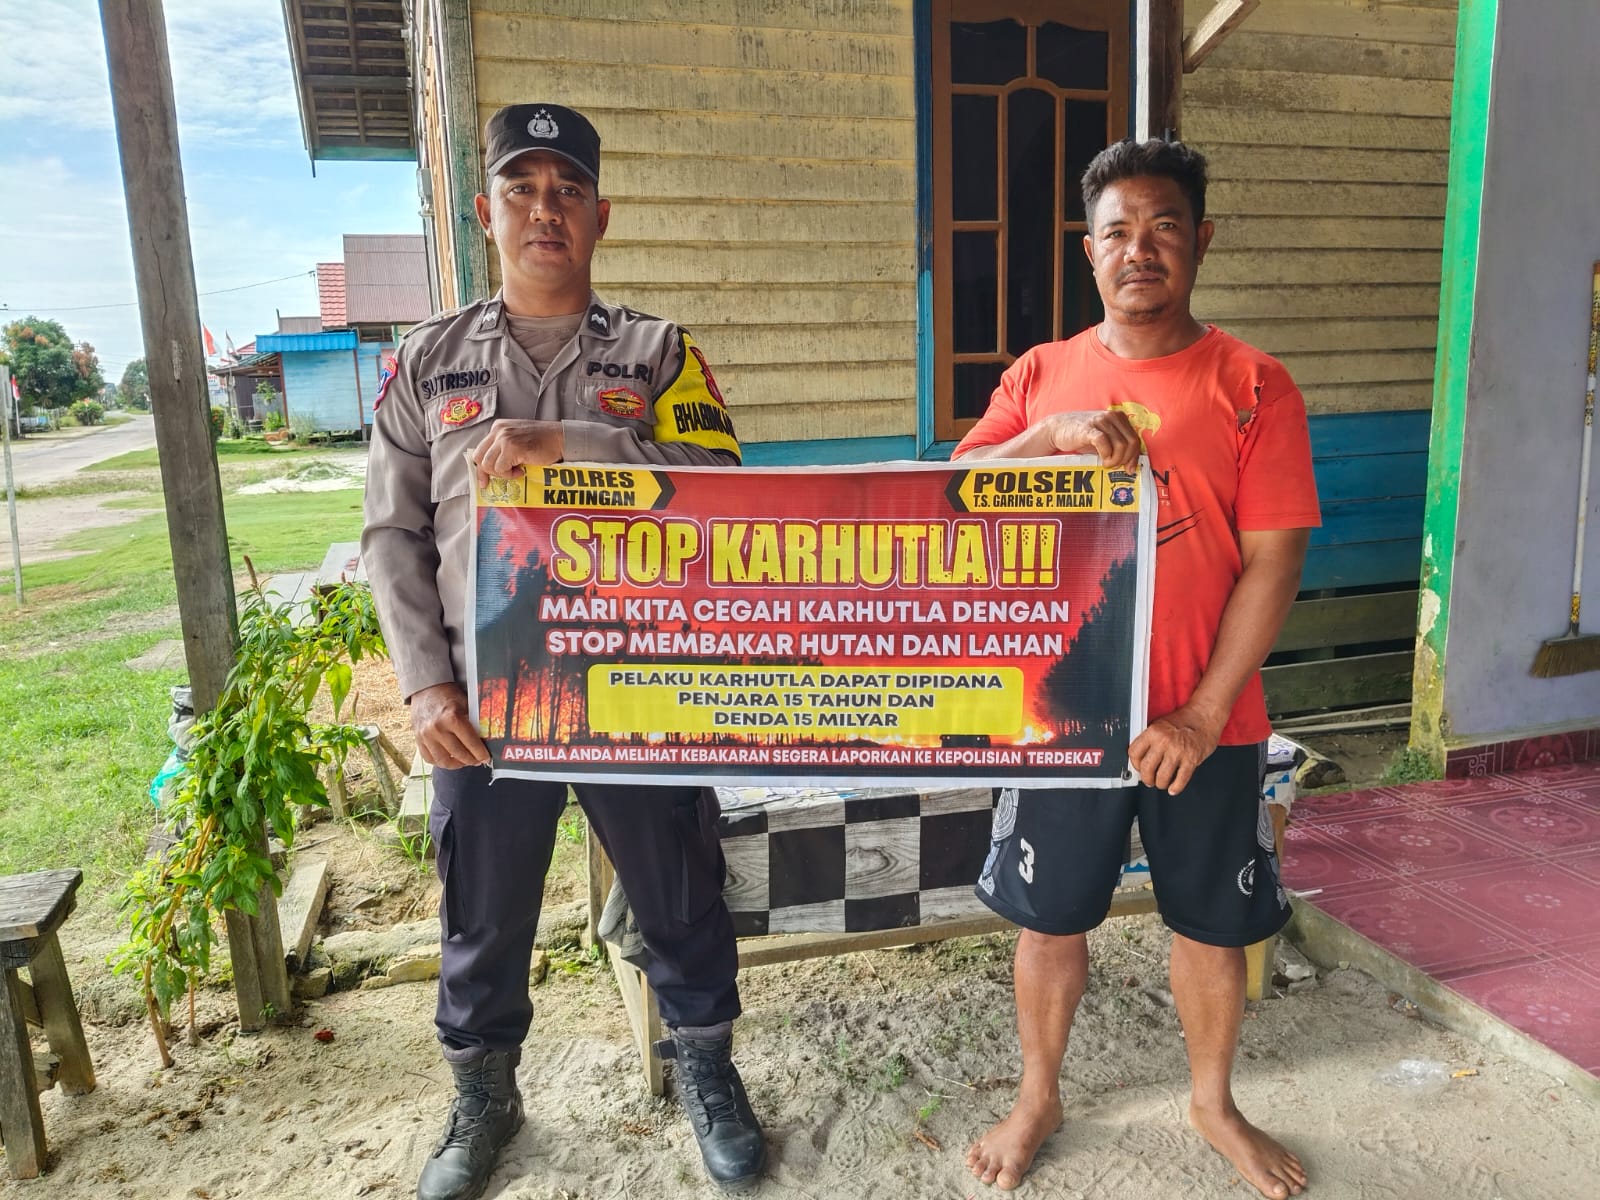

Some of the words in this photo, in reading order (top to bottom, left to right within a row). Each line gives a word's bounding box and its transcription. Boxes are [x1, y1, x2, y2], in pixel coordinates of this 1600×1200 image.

[421, 369, 491, 400] SUTRISNO
[543, 467, 634, 488] POLRES
[973, 470, 1095, 493] POLSEK
[543, 489, 635, 506] KATINGAN
[974, 495, 989, 508] T.S.
[993, 495, 1034, 508] GARING
[1035, 497, 1043, 507] &
[1046, 495, 1055, 507] P.
[1056, 495, 1093, 508] MALAN
[556, 519, 698, 582] STOP
[713, 522, 988, 585] KARHUTLA
[1001, 524, 1057, 584] !!!
[541, 598, 617, 621] MARI
[625, 598, 688, 622] KITA
[693, 599, 791, 622] CEGAH
[799, 600, 947, 623] KARHUTLA
[953, 600, 1069, 623] DENGAN
[548, 631, 623, 654] STOP
[631, 633, 794, 655] MEMBAKAR
[801, 634, 895, 656] HUTAN
[902, 634, 961, 656] DAN
[968, 634, 1062, 656] LAHAN
[610, 672, 694, 687] PELAKU
[700, 673, 815, 688] KARHUTLA
[820, 674, 891, 688] DAPAT
[895, 674, 1003, 689] DIPIDANA
[679, 692, 779, 706] PENJARA
[784, 693, 804, 707] 15
[808, 693, 884, 707] TAHUN
[888, 694, 934, 708] DAN
[714, 712, 789, 726] DENDA
[793, 713, 813, 727] 15
[818, 713, 899, 727] MILYAR
[505, 748, 567, 761] APABILA
[569, 748, 612, 761] ANDA
[615, 748, 677, 762] MELIHAT
[681, 749, 770, 763] KEBAKARAN
[772, 749, 830, 763] SEGERA
[832, 750, 913, 764] LAPORKAN
[914, 750, 932, 763] KE
[936, 750, 1021, 765] KEPOLISIAN
[1028, 751, 1102, 765] TERDEKAT
